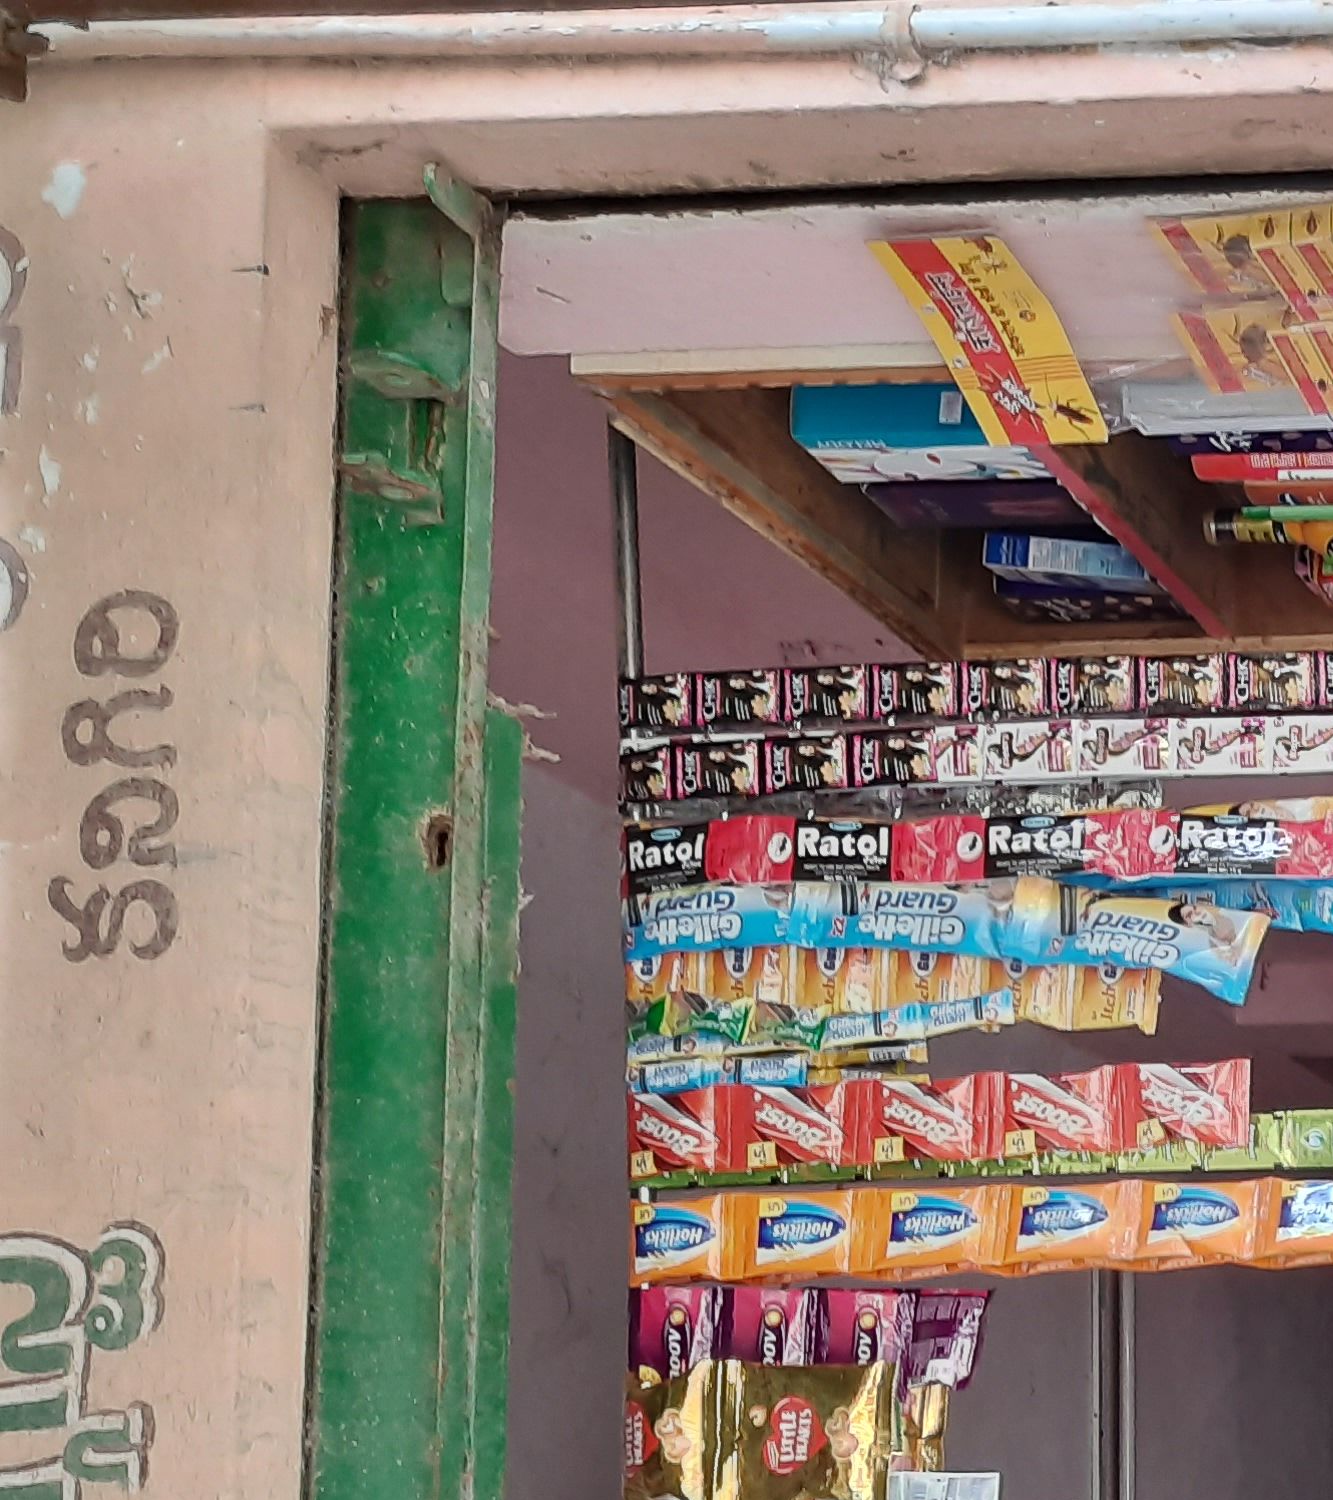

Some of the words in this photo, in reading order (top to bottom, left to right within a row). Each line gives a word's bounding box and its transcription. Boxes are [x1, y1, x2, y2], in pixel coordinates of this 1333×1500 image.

[47, 588, 180, 964] కనిగిరి
[797, 824, 891, 857] Ratol
[988, 818, 1086, 857] Ratol
[878, 888, 958, 913] Guard
[858, 915, 964, 944] Gillette
[1085, 912, 1176, 942] Guard
[1074, 932, 1180, 967] Gillette
[640, 1220, 704, 1244] Horlicks
[773, 1219, 835, 1239] Horlicks
[905, 1212, 969, 1232] Horlicks
[780, 1410, 798, 1462] LITTLE
